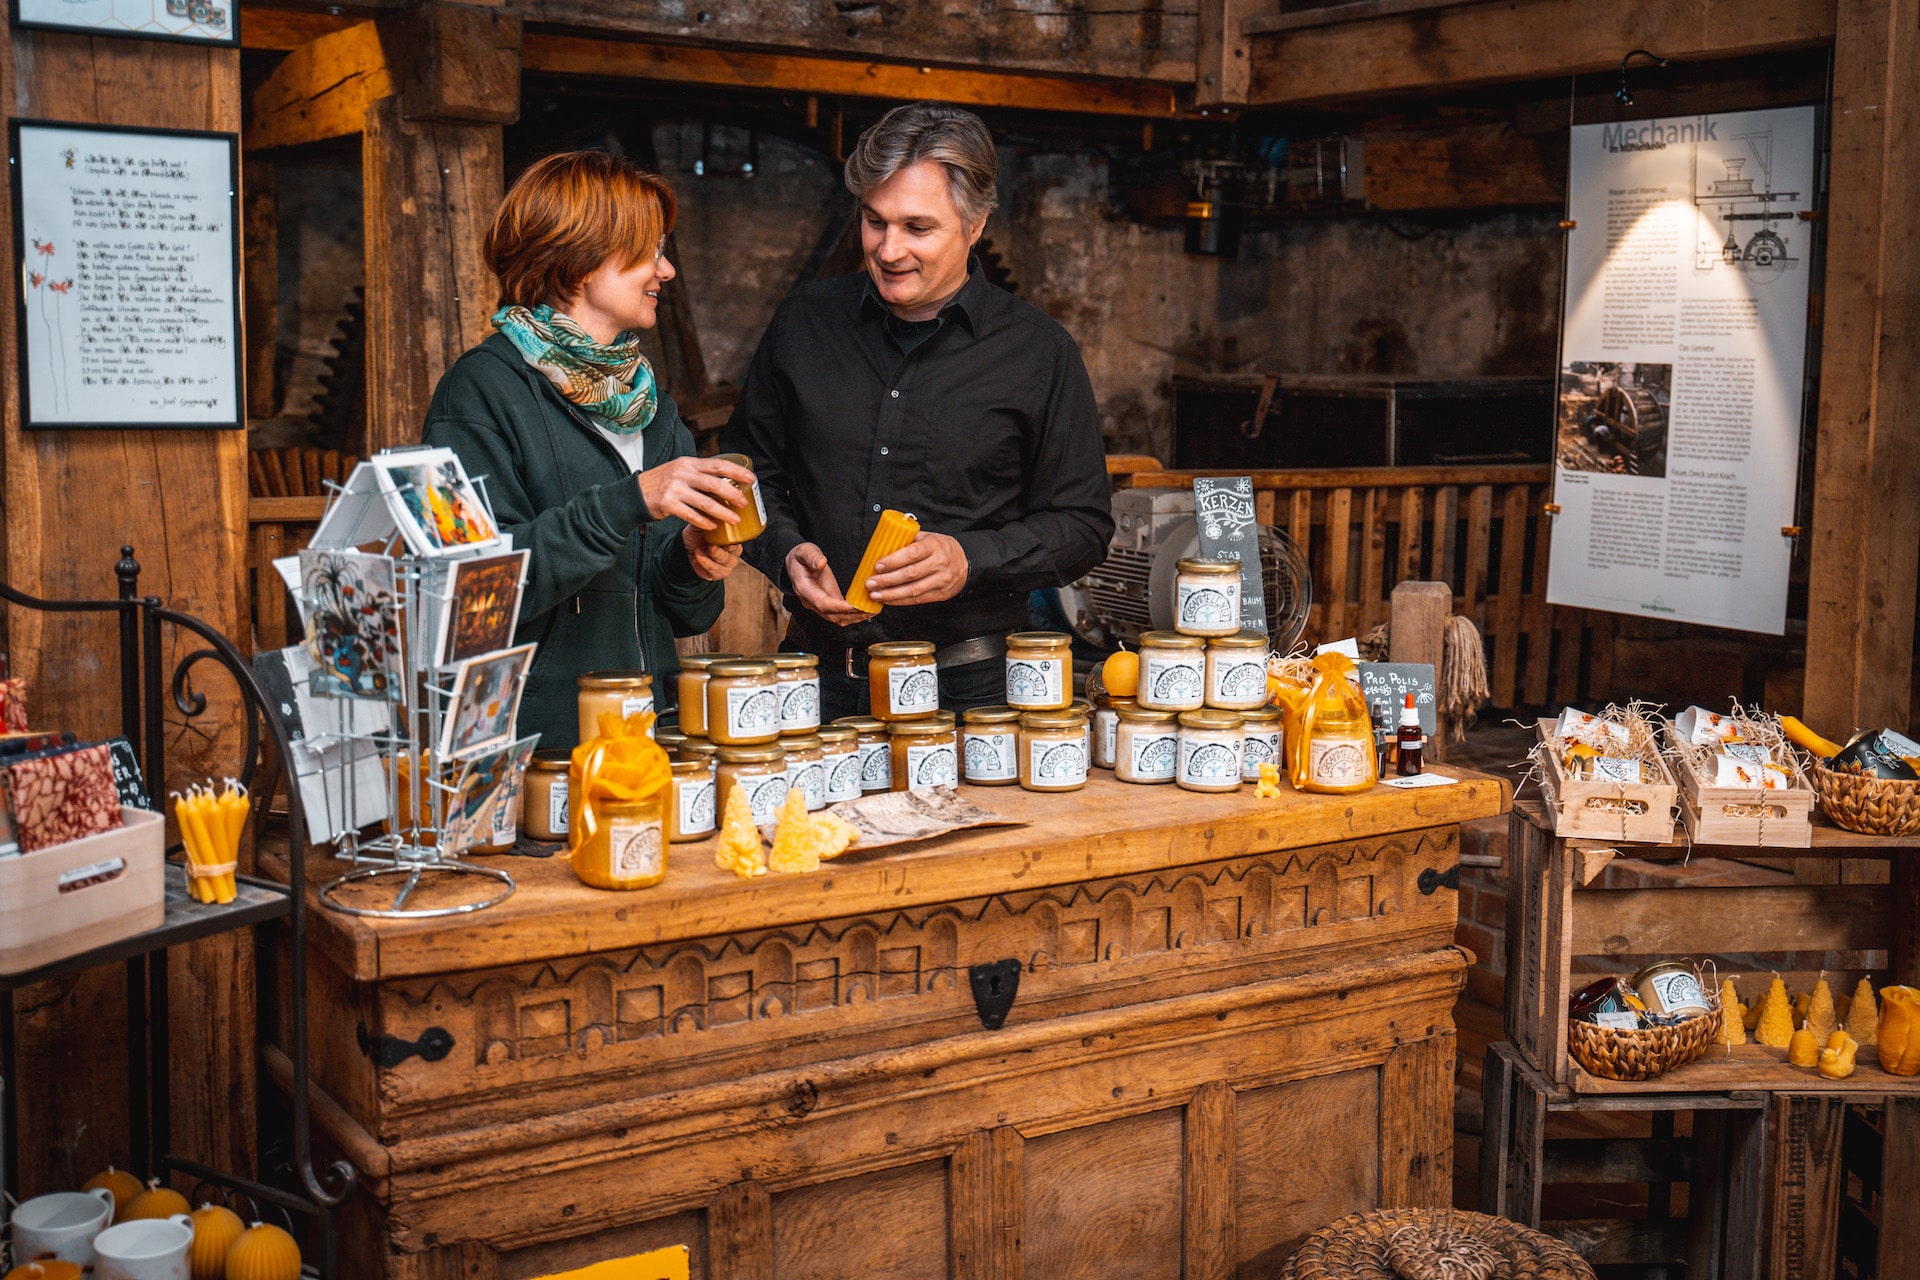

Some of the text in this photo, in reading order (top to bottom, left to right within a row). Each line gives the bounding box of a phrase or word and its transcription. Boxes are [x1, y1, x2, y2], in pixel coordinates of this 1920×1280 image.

[1603, 115, 1718, 149] Mechanik
[1199, 494, 1254, 516] KERZEN
[1217, 550, 1241, 560] STAB
[1363, 671, 1424, 687] PRO POLIS
